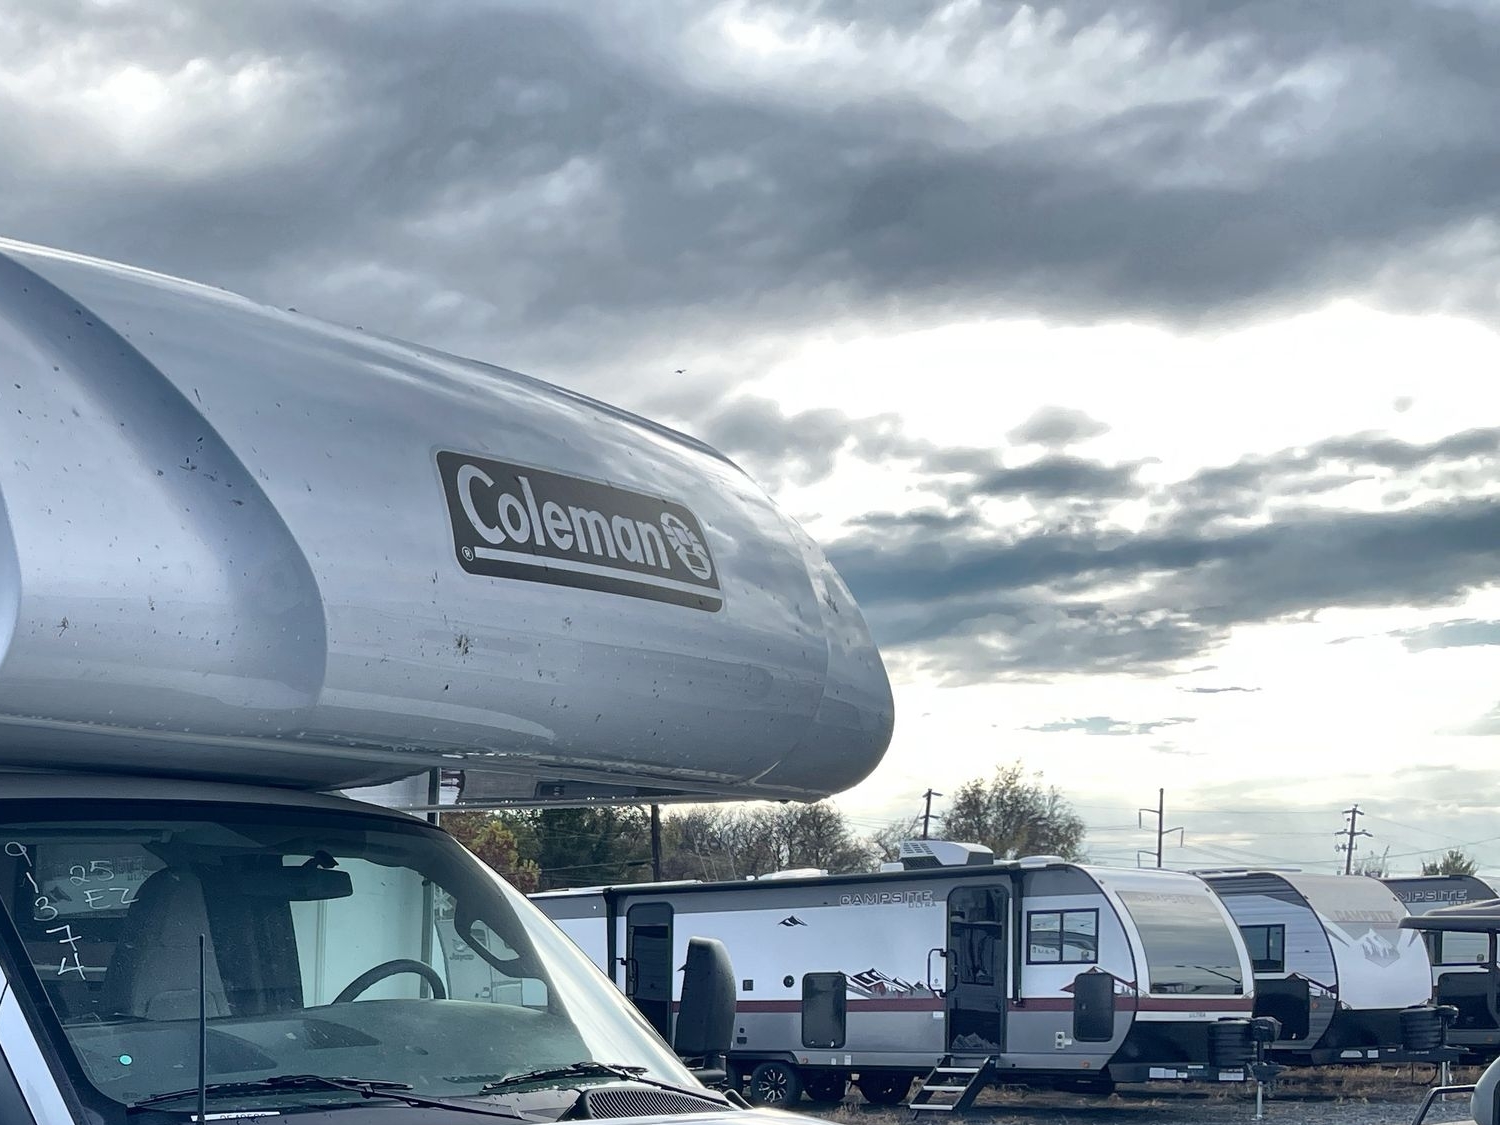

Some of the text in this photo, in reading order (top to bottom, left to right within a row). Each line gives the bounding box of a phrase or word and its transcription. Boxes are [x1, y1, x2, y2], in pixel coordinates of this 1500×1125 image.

[457, 464, 671, 570] Coleman
[69, 860, 114, 886] 25
[840, 890, 934, 906] CAMPSITE
[1398, 889, 1468, 902] MPSITE
